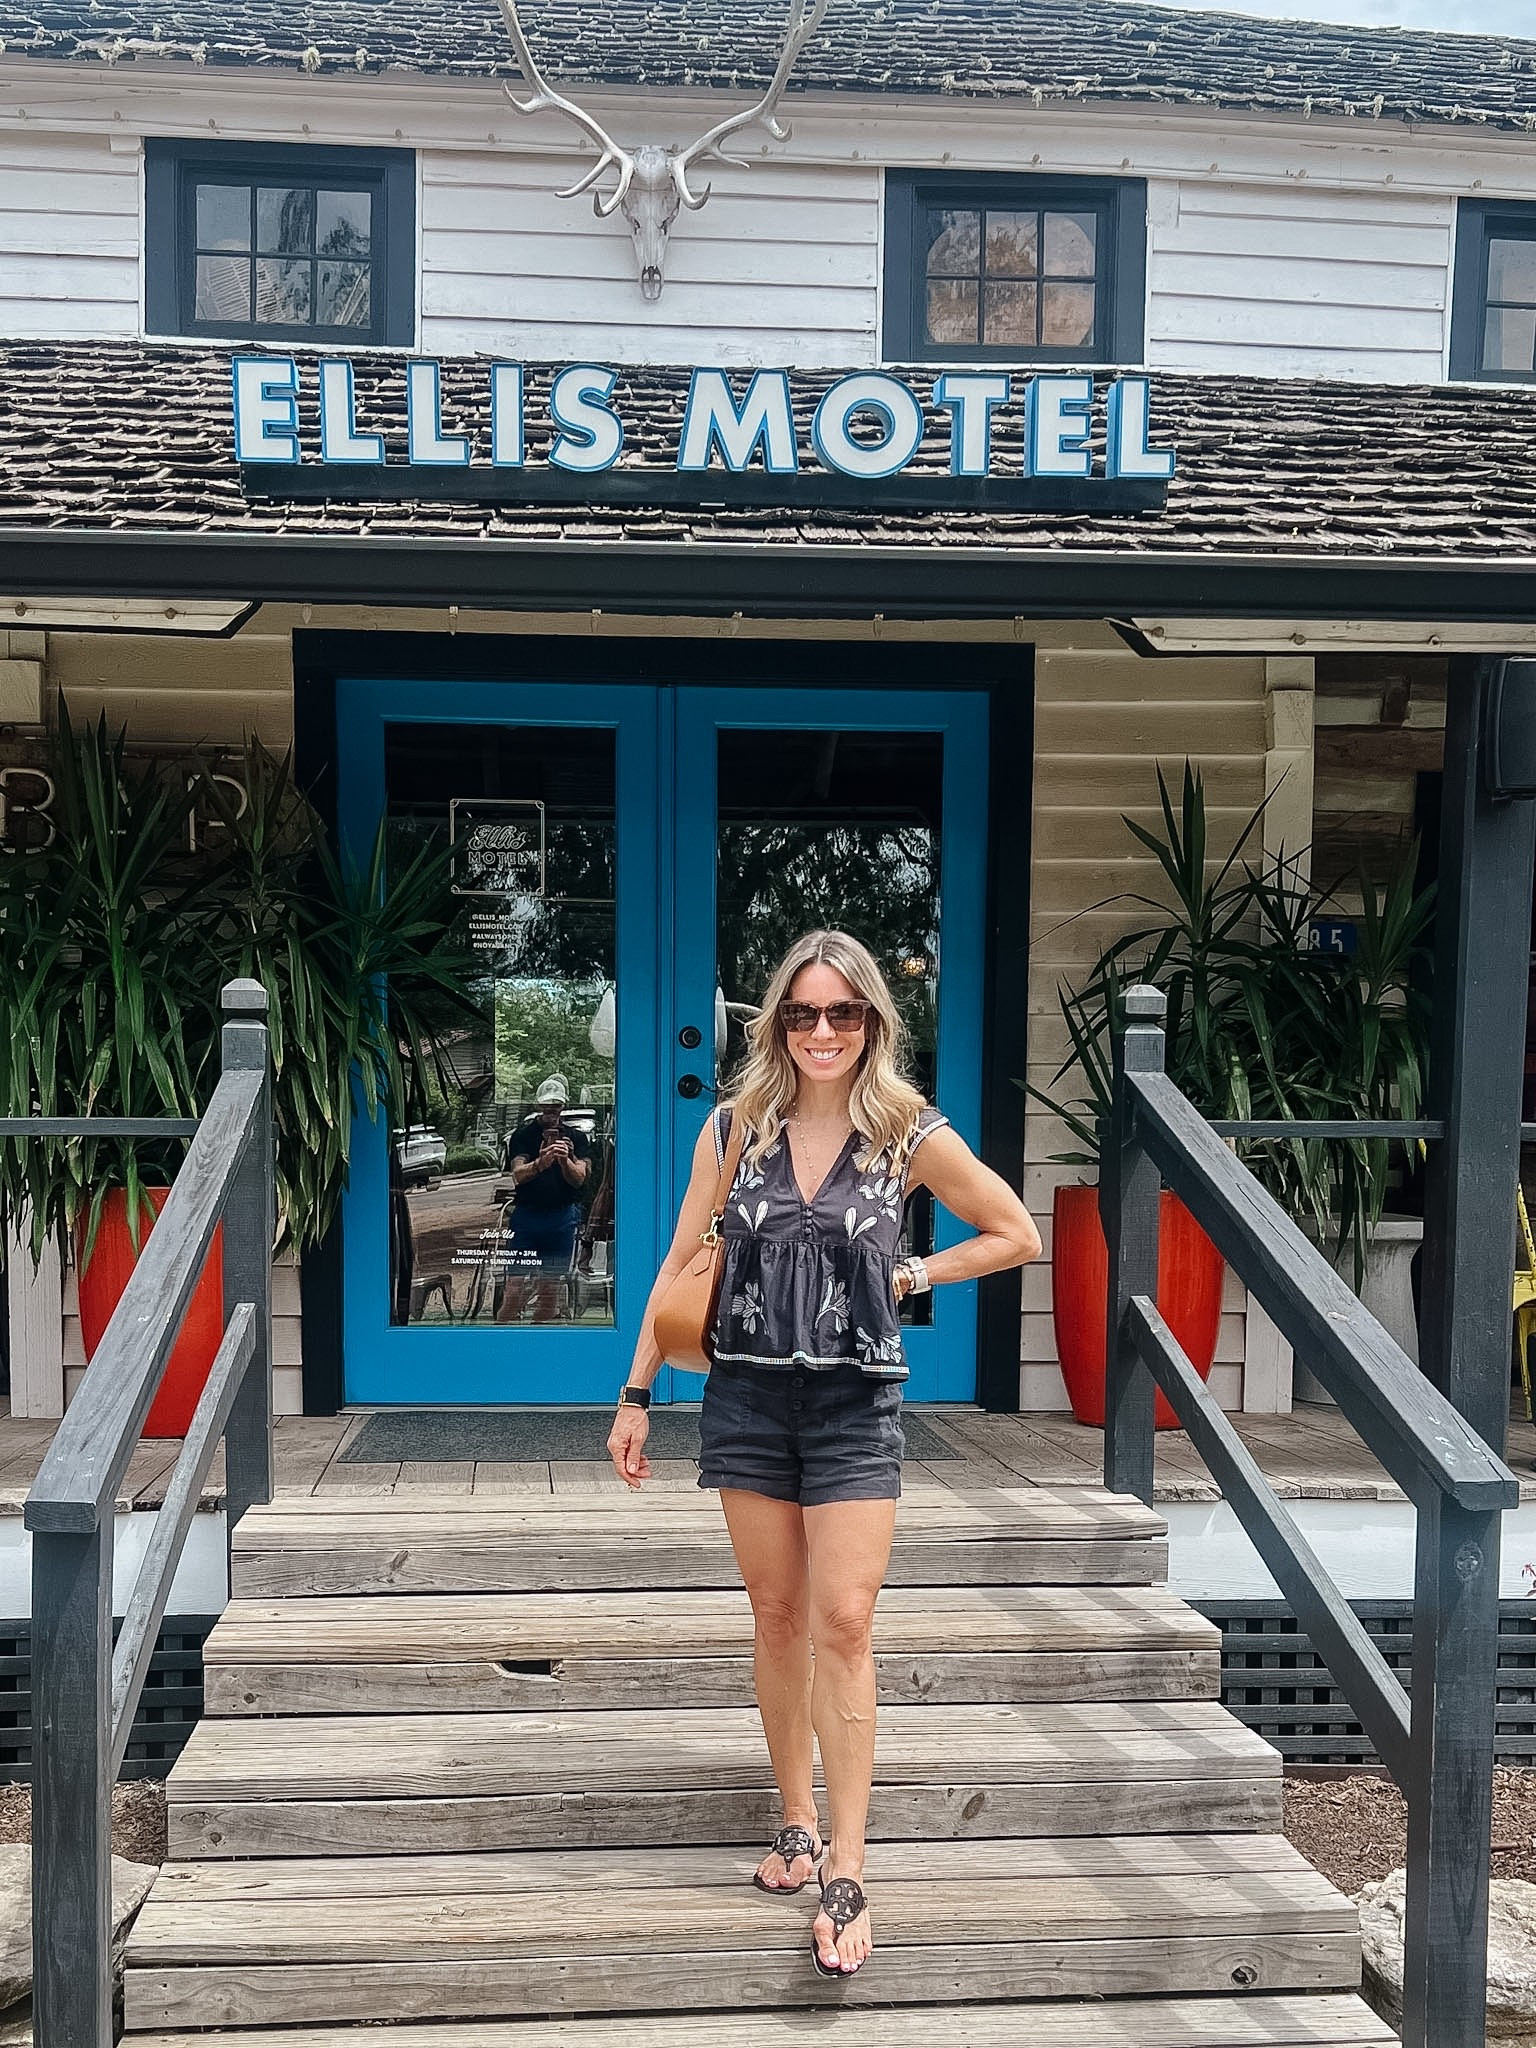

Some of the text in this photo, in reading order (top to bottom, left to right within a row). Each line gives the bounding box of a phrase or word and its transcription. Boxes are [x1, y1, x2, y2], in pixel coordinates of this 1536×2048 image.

[232, 356, 1176, 479] ELLIS MOTEL
[468, 824, 527, 850] Ellis
[468, 852, 527, 865] MOTEL
[480, 1228, 516, 1240] Join Us
